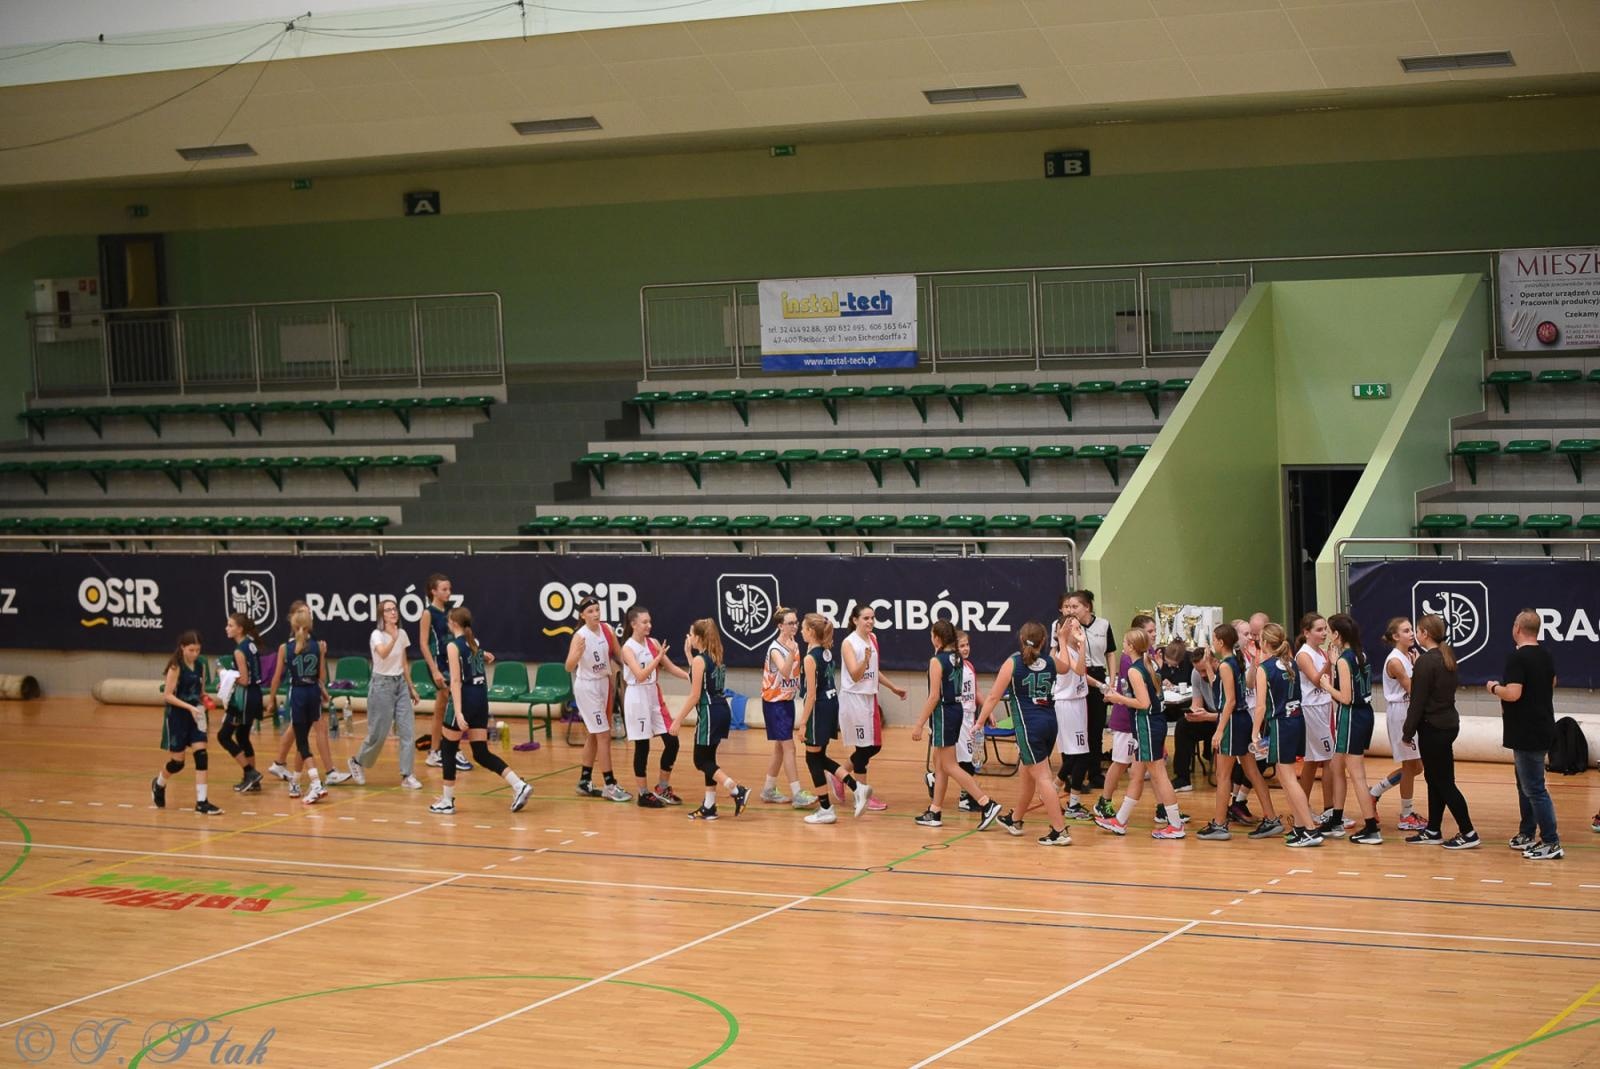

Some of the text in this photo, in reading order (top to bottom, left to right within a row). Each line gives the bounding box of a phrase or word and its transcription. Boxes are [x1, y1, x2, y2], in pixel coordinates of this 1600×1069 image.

[1064, 159, 1082, 174] B
[414, 199, 434, 214] A
[781, 289, 893, 317] instal-tech
[803, 355, 877, 366] www.instal-tech.pl
[78, 577, 162, 615] OSiR
[112, 615, 163, 629] RACIBÓRZ
[1535, 608, 1600, 641] RA
[593, 651, 600, 662] 6
[292, 654, 317, 676] 12
[1022, 672, 1052, 699] 15
[595, 714, 602, 725] 6
[640, 720, 645, 732] 7
[856, 728, 865, 739] 13
[1075, 734, 1086, 746] 16
[1323, 740, 1331, 752] 9
